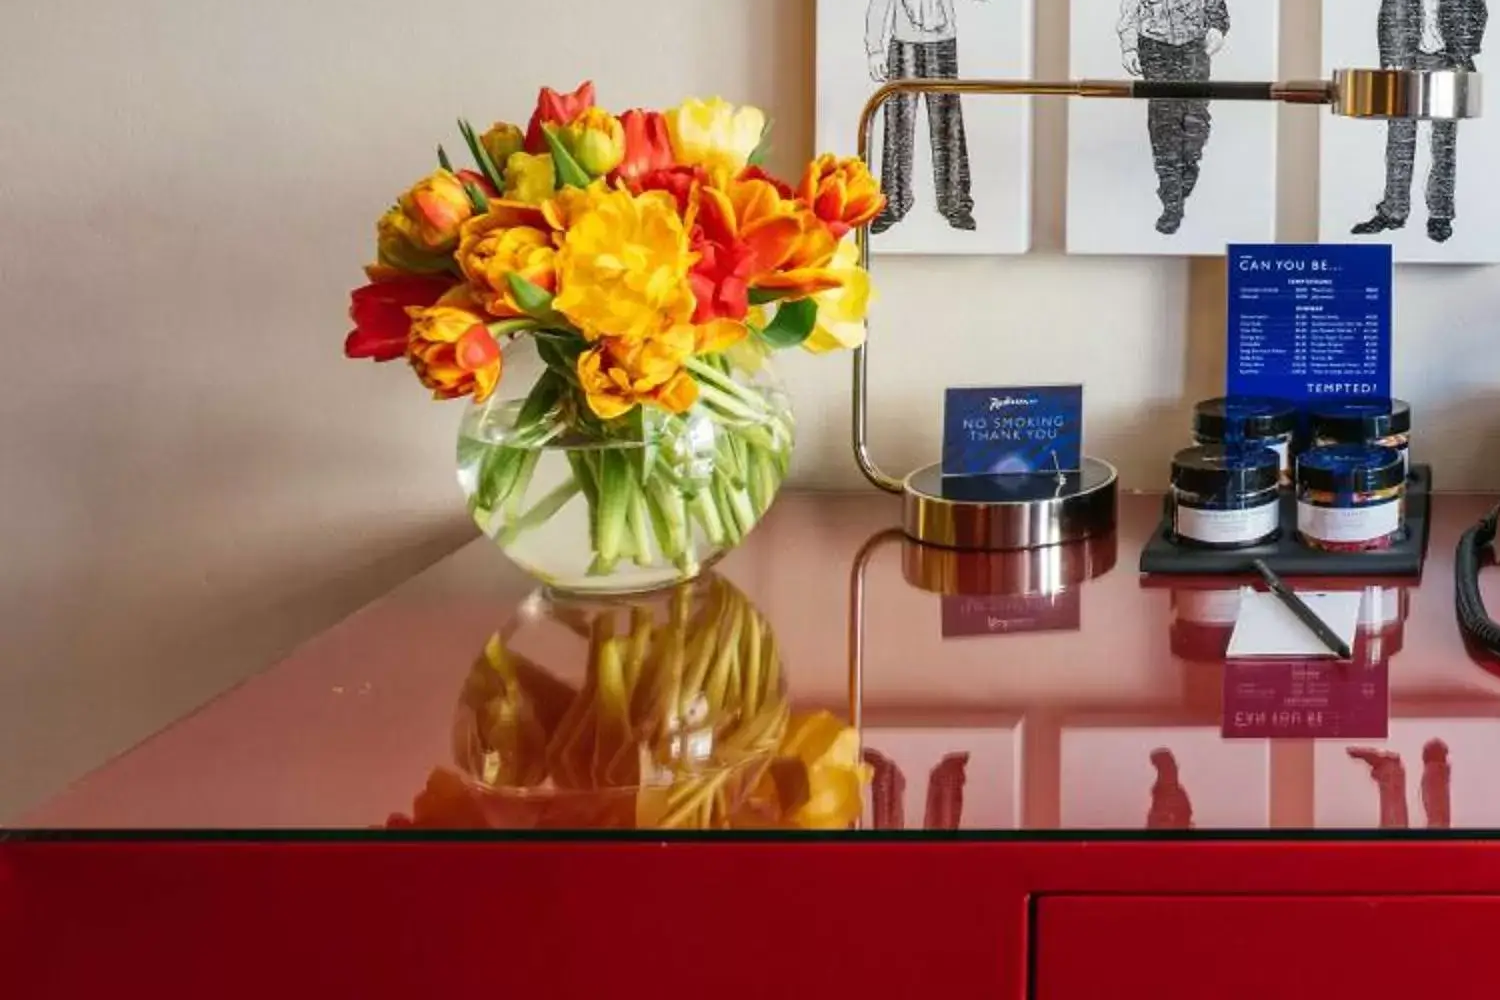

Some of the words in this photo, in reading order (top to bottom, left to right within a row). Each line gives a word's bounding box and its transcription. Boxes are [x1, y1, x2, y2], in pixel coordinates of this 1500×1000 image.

[1239, 260, 1271, 271] CAN
[1275, 260, 1305, 271] YOU
[963, 418, 987, 429] NO
[994, 415, 1064, 428] SMOKING
[969, 430, 1021, 440] THANK
[1027, 428, 1057, 440] YOU
